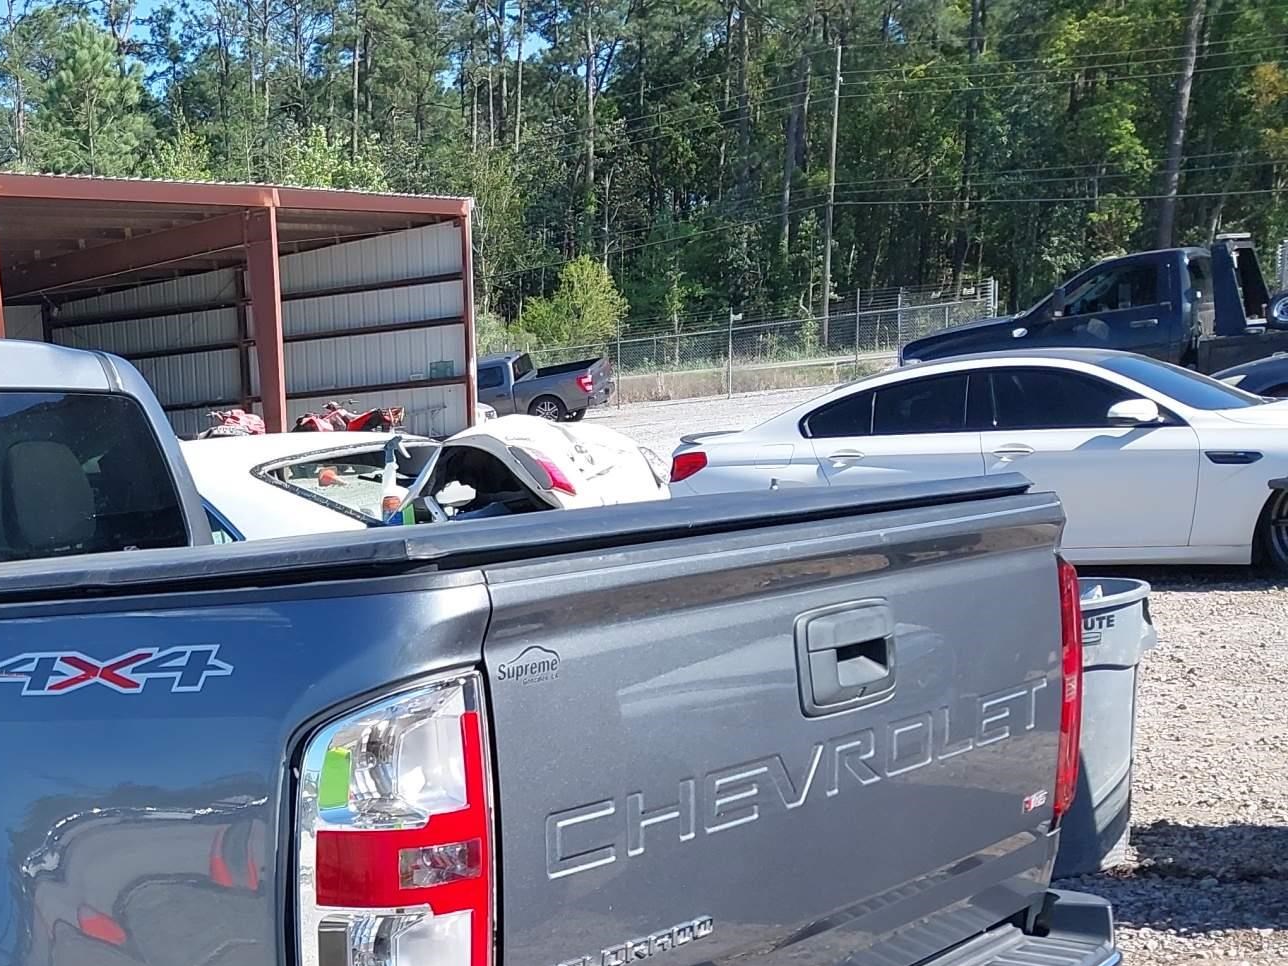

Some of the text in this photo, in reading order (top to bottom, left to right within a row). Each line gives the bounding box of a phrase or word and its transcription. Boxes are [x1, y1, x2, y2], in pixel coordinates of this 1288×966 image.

[1083, 614, 1115, 631] UTE
[497, 658, 558, 681] Supreme
[545, 678, 1048, 880] CHEVROLET
